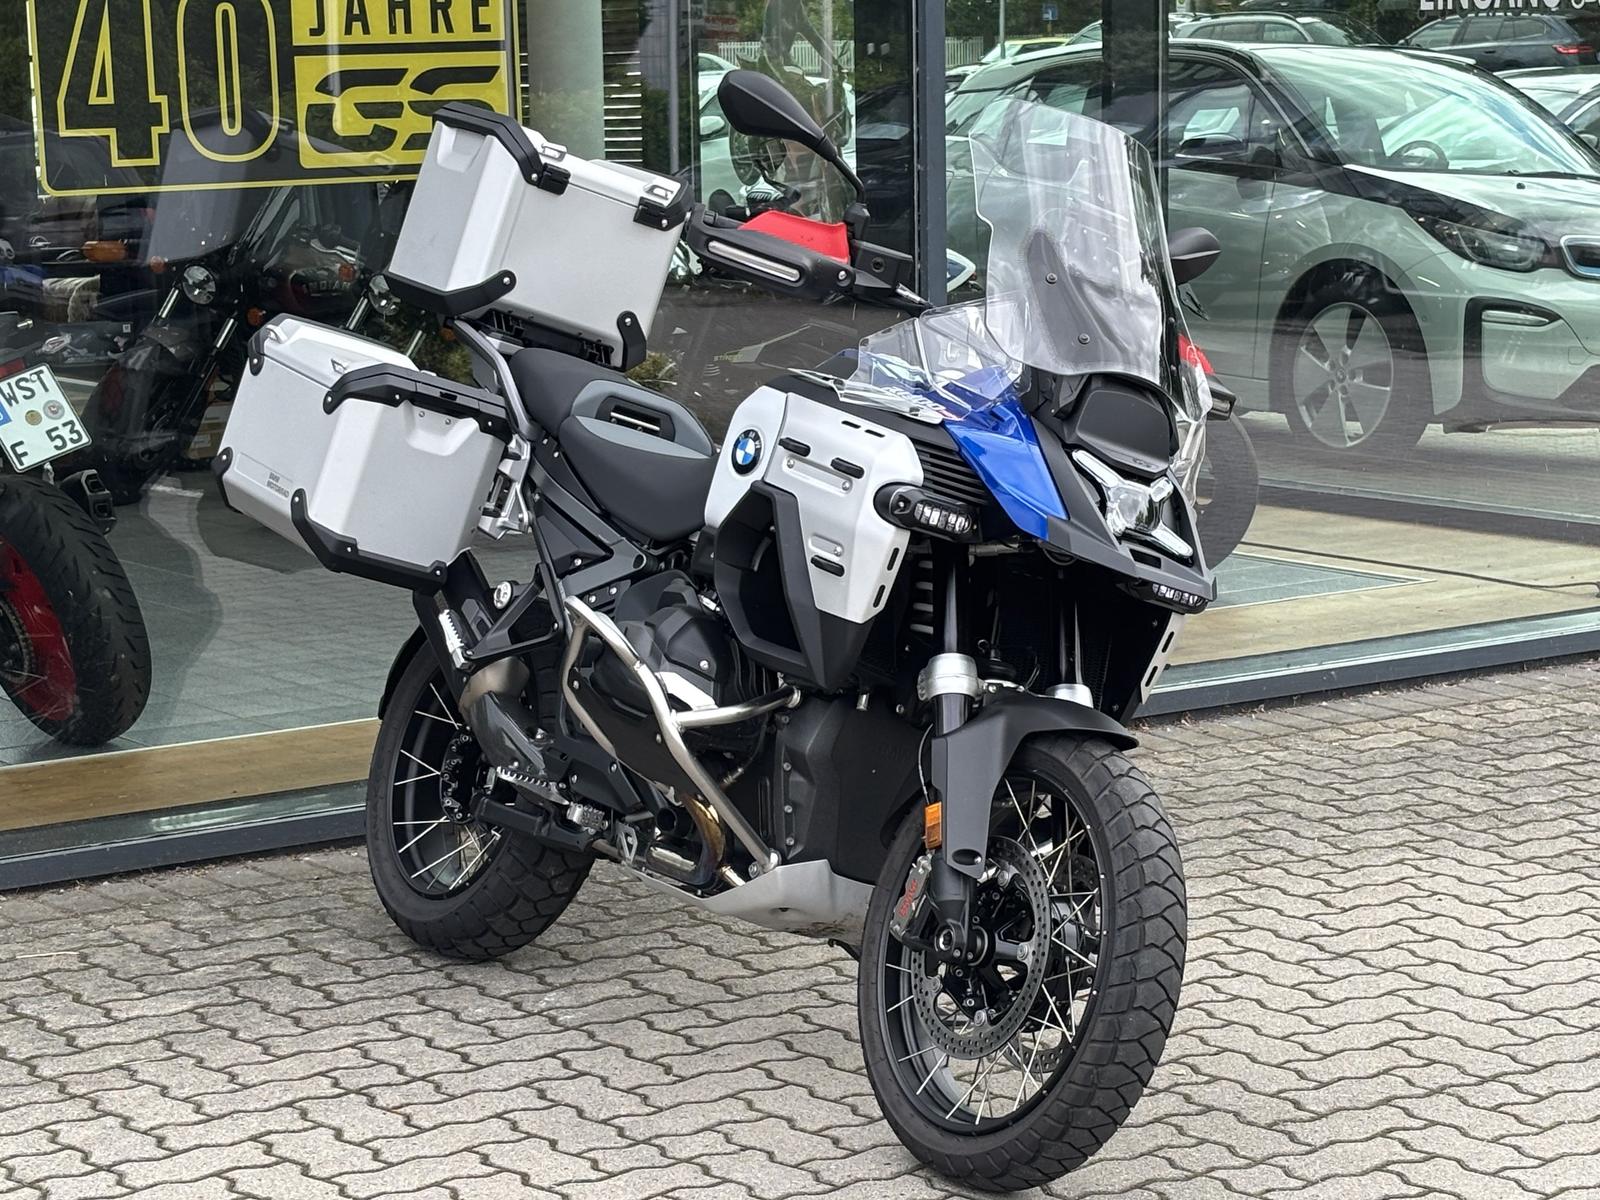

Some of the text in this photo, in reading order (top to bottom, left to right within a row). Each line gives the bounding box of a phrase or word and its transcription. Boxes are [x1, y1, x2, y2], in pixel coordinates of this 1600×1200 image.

[309, 0, 492, 37] JAHRE
[57, 0, 280, 168] 40
[304, 65, 501, 154] GS
[0, 370, 49, 407] WST
[10, 420, 83, 466] F 53
